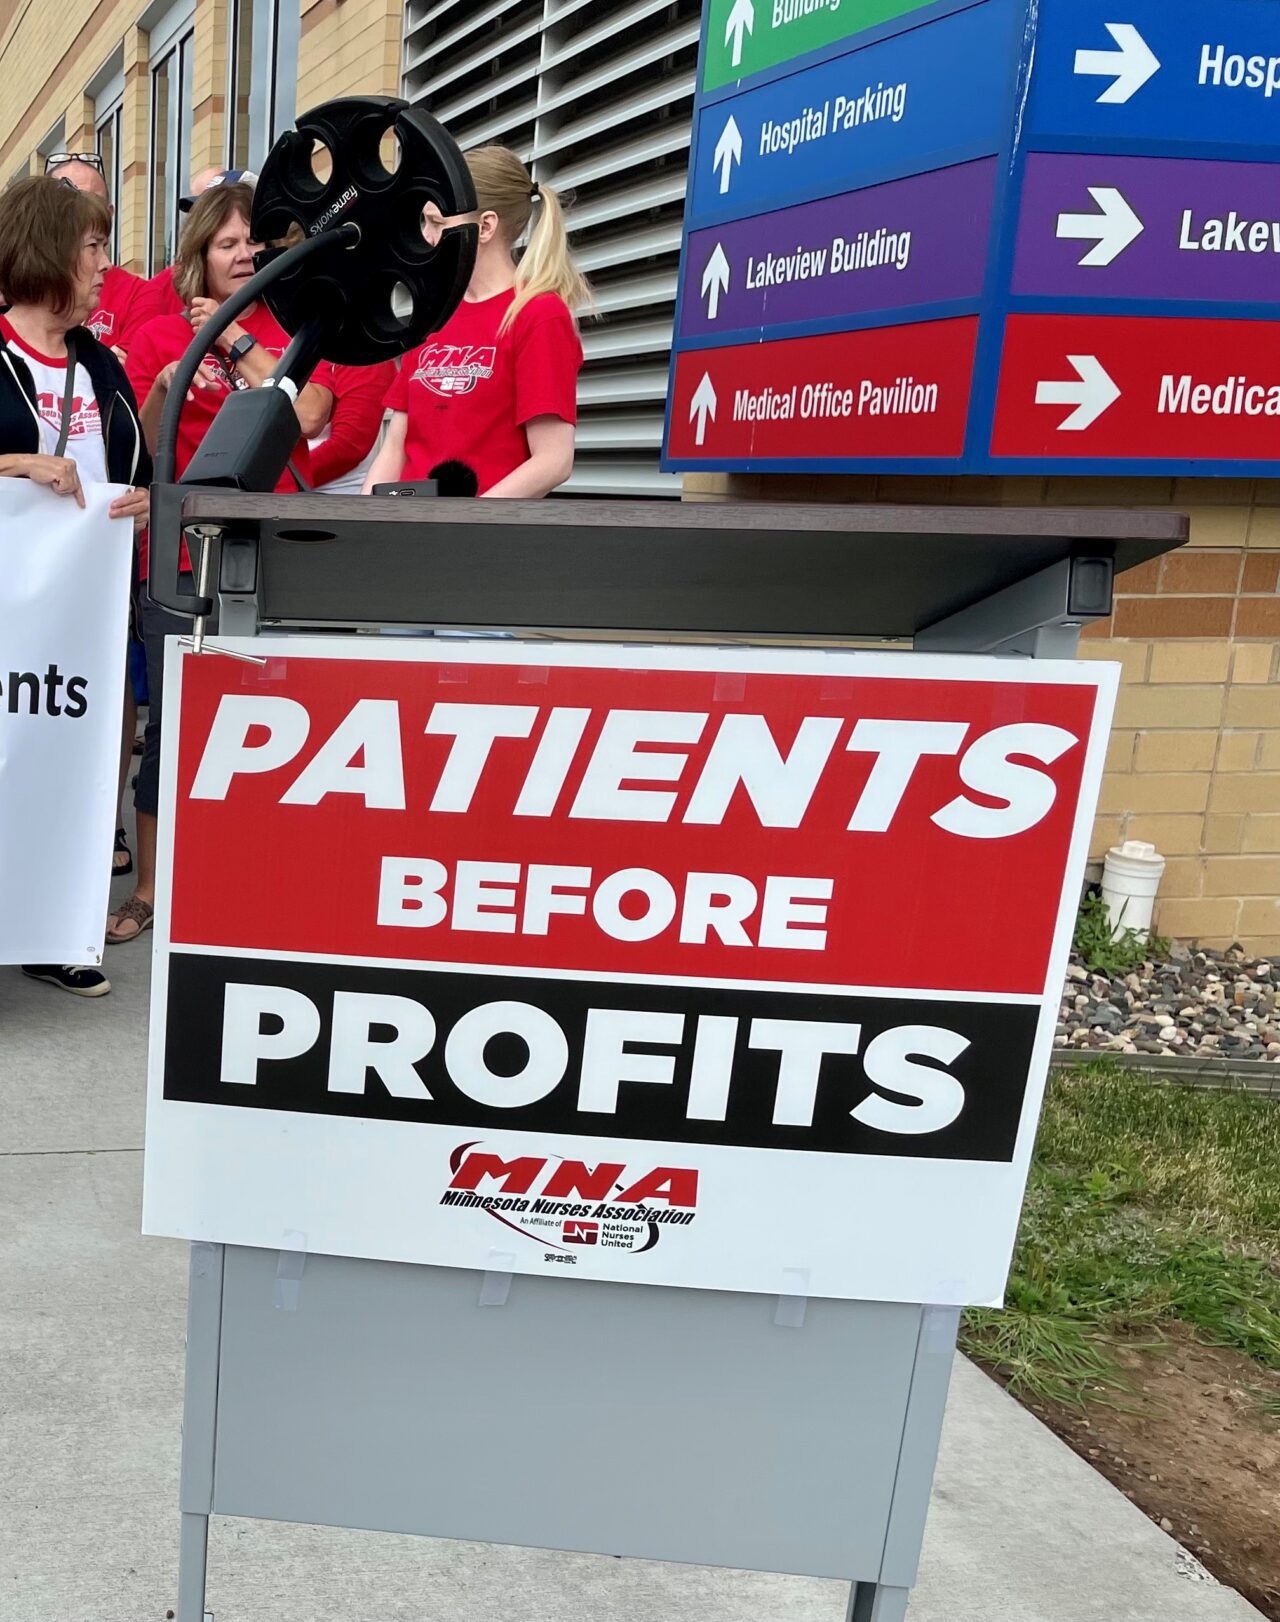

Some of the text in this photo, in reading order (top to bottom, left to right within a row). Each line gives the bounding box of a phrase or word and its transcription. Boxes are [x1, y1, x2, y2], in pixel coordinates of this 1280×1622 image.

[759, 82, 907, 155] Hospital Parking
[310, 185, 358, 235] frameworks
[745, 228, 911, 289] Lakeview Building
[733, 377, 938, 421] Medical Office Pavilion
[1157, 374, 1280, 416] Medica
[189, 694, 1079, 839] PATIENTS
[376, 856, 834, 951] BEFORE
[220, 982, 972, 1135] PROFITS
[448, 1152, 699, 1208] MNA
[439, 1190, 696, 1225] Minnesota Nurses Association
[520, 1217, 529, 1225] An
[530, 1217, 553, 1227] Affiliate
[553, 1219, 562, 1227] of
[602, 1223, 643, 1233] National
[600, 1240, 633, 1249] United
[601, 1231, 634, 1240] Nurses
